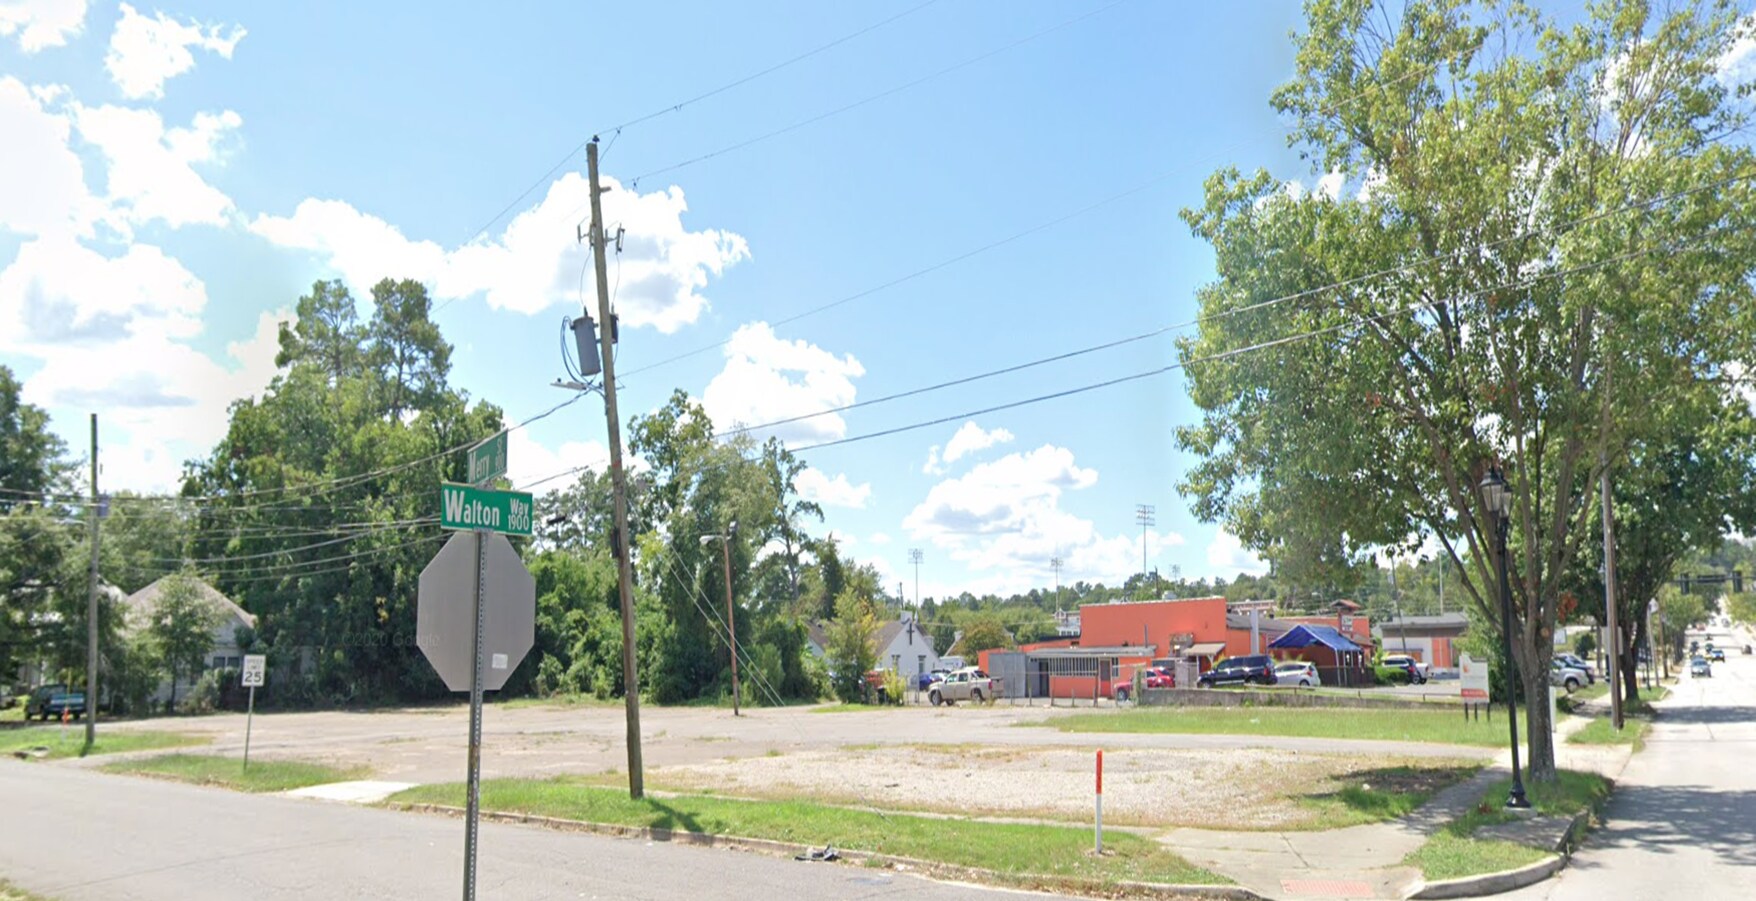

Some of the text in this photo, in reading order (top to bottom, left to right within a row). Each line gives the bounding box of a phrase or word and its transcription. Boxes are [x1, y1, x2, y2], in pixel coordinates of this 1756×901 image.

[469, 451, 490, 483] Merry
[444, 488, 529, 526] Walton Way
[508, 514, 530, 531] 1900
[244, 671, 262, 683] 25
